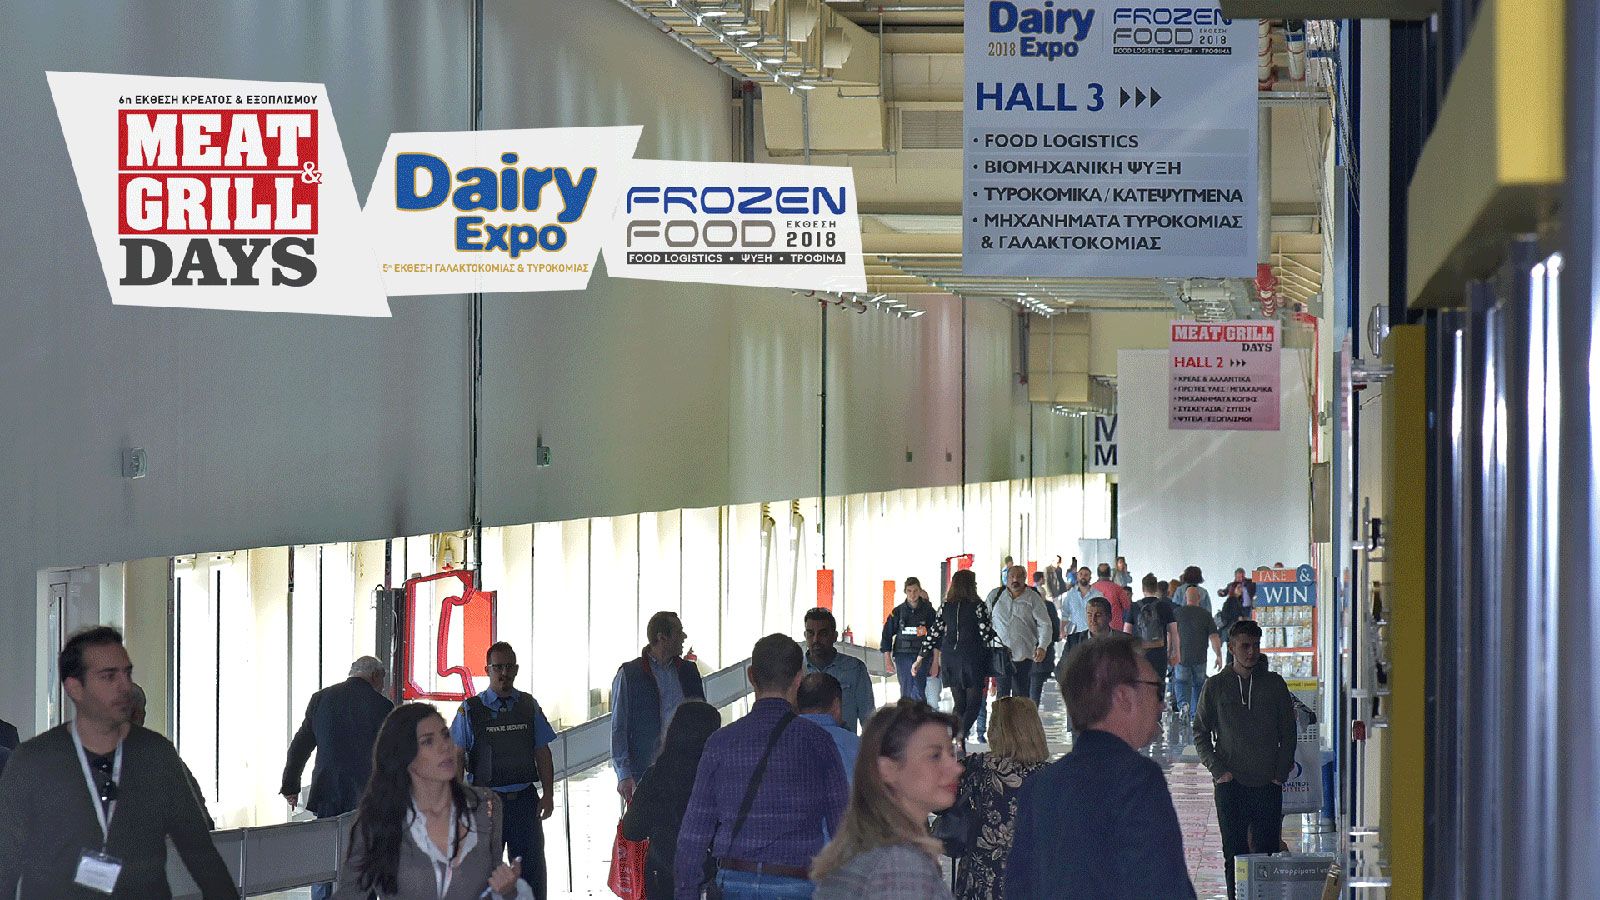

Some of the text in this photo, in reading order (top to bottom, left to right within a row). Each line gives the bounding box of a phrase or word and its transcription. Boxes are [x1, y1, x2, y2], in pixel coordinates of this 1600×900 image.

[988, 0, 1095, 42] Dairy
[1113, 28, 1193, 45] FOOD
[1199, 36, 1227, 45] 2018
[988, 37, 1079, 61] 2018 Expo
[976, 82, 1105, 112] HALL 3
[984, 134, 1139, 148] FOOD LOGISTICS
[984, 160, 1182, 175] ΒΙΟΜΗΧΑΝΙΚΗ ΨΥΞΗ
[984, 187, 1101, 202] ΤΥΡΟΚΟΜΙΚΑ
[1113, 188, 1243, 203] ΚΑΤΕΨΥΓΜΕΝΑ
[984, 213, 1243, 229] ΜΗΧΑΝΗΜΑΤΑ ΤΥΡΟΚΟΜΙΑΣ
[981, 236, 1162, 250] & ΓΑΛΑΚΤΟΚΟΜΙΑΣ
[1175, 326, 1273, 340] MEAT GRILL
[1241, 343, 1273, 352] DAYS
[1174, 357, 1224, 368] HALL 2
[1258, 568, 1312, 583] TAKE &
[1263, 586, 1308, 603] WIN
